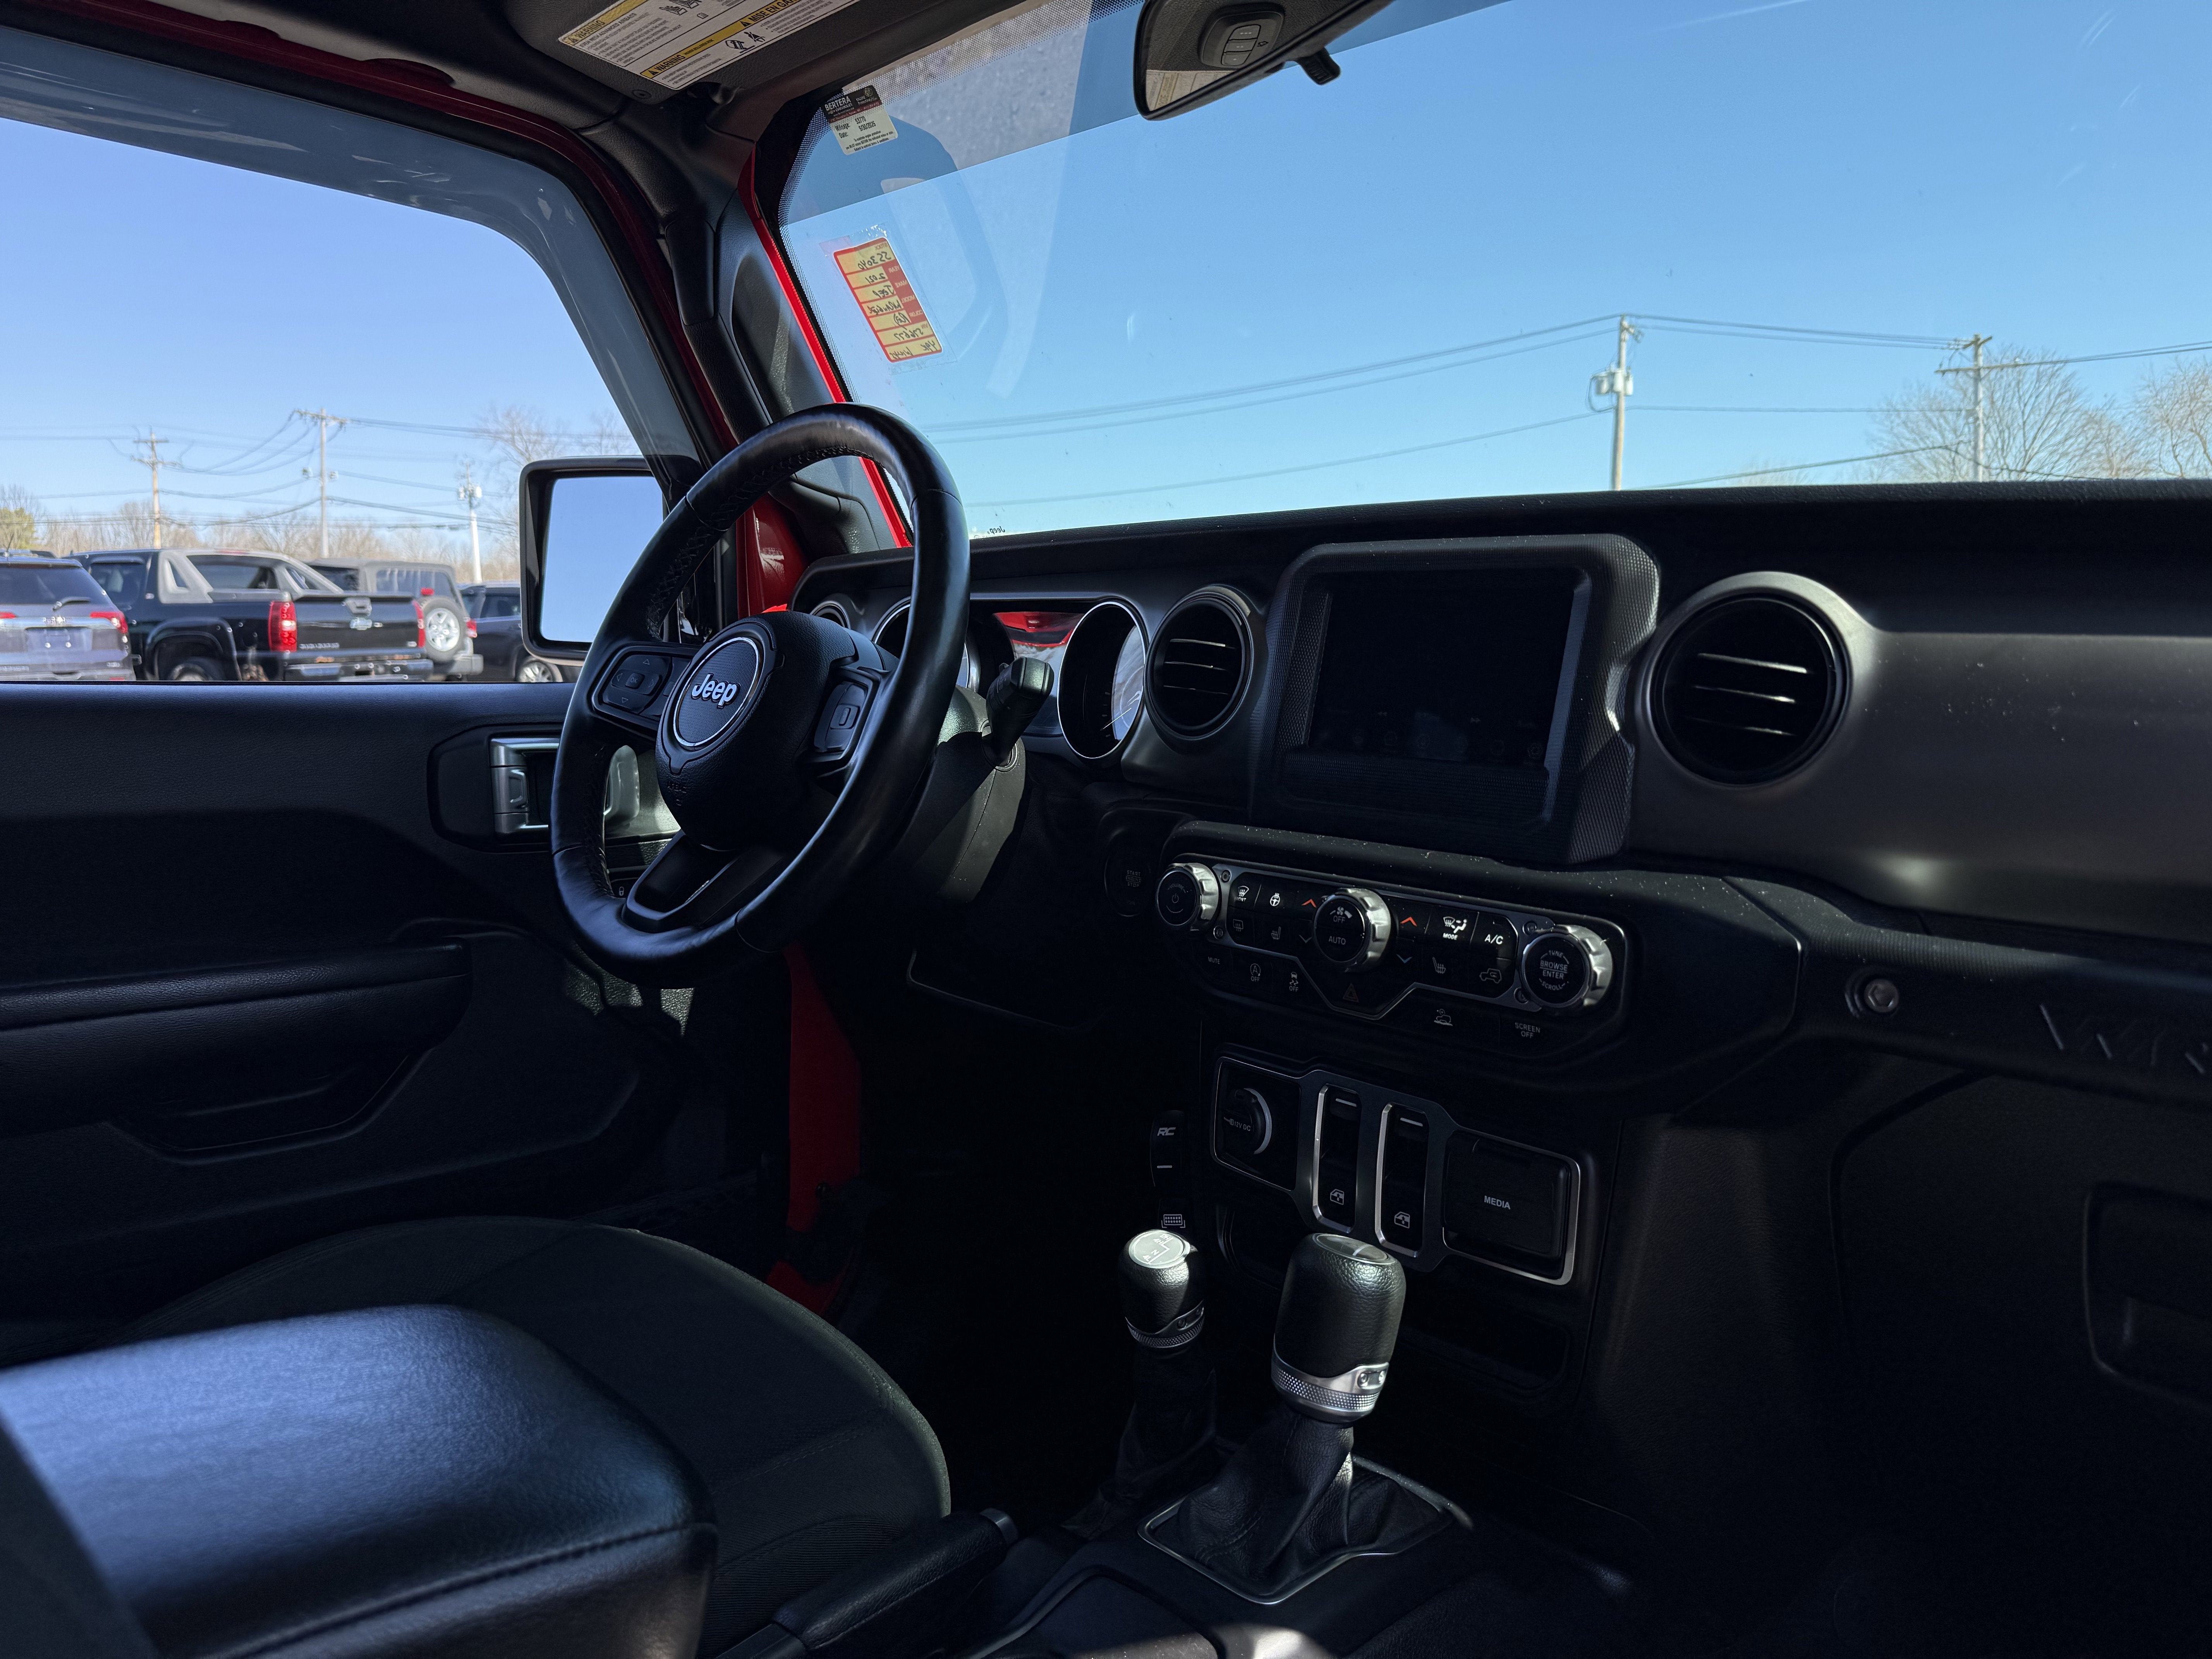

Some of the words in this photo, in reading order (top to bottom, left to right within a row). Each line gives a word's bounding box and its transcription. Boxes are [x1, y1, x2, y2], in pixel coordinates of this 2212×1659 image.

[750, 11, 769, 22] MISE
[766, 5, 780, 13] EN
[575, 20, 605, 38] WARNING
[654, 55, 686, 71] WARNING
[825, 96, 851, 111] BERTERA
[691, 673, 737, 708] Jeep
[1328, 936, 1346, 945] AUTO
[1485, 934, 1503, 945] A/C
[1540, 960, 1568, 972] BROWSE
[1542, 970, 1564, 980] ENTER
[1541, 981, 1563, 991] SCROLL
[1515, 1022, 1540, 1033] SCREEN
[1157, 1127, 1176, 1136] RC
[1484, 1195, 1511, 1209] MEDIA
